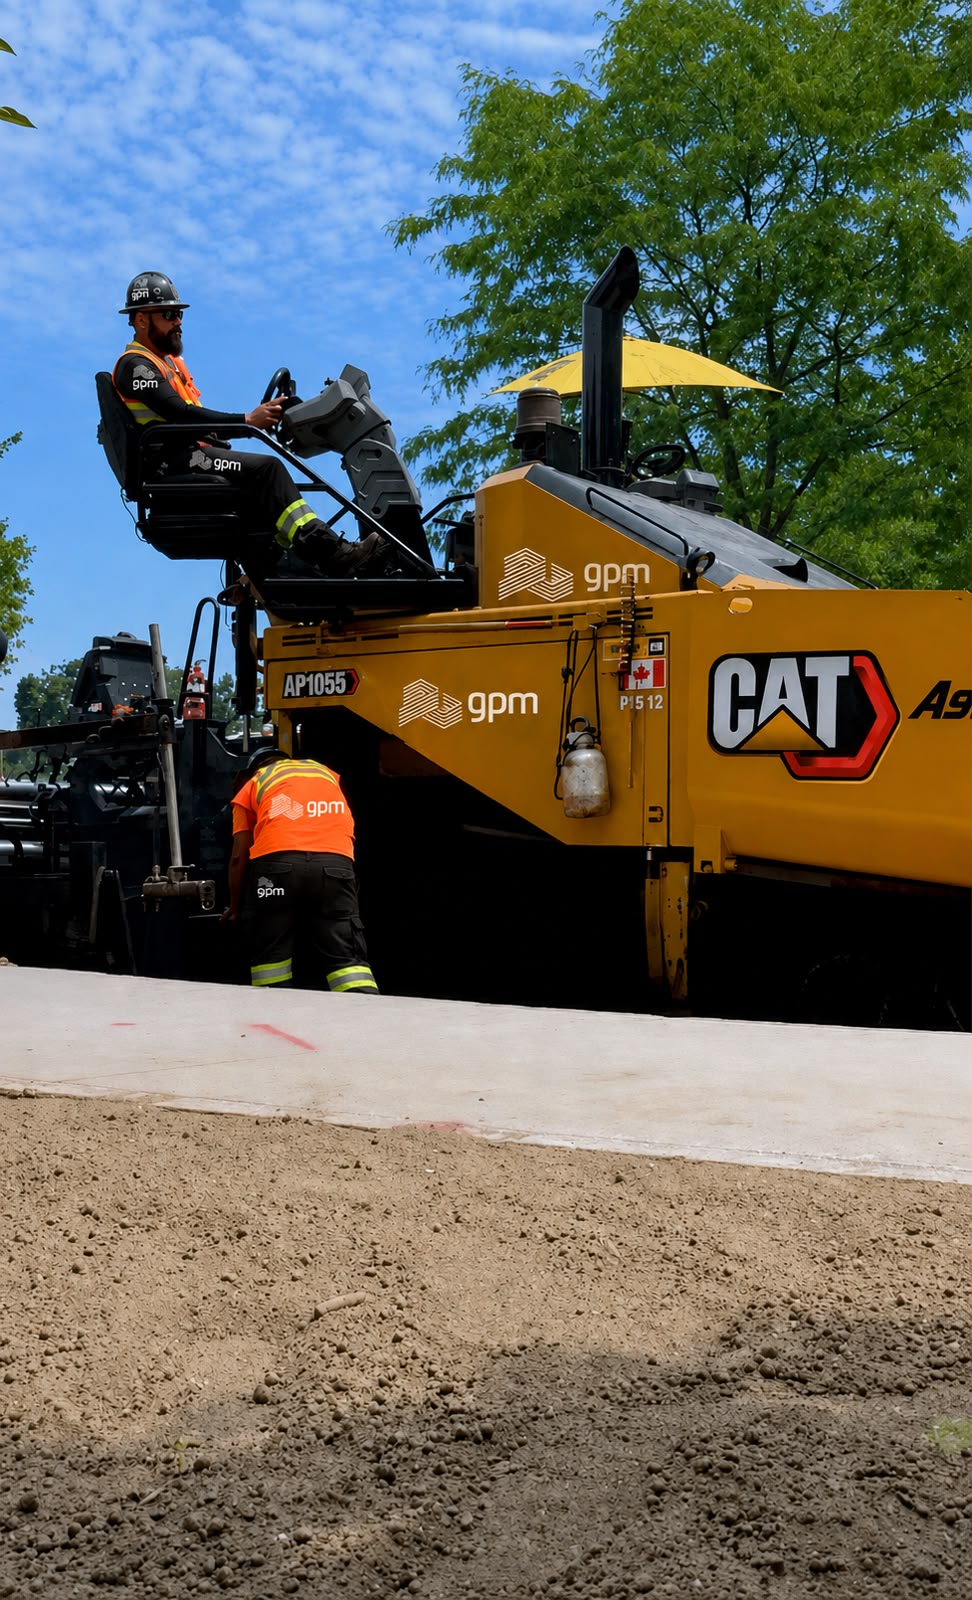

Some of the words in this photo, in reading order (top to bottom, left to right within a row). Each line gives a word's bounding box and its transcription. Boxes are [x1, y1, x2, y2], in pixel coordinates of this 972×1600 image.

[132, 379, 159, 391] gpm
[213, 458, 242, 471] gpm
[583, 563, 650, 592] gpm
[283, 670, 347, 698] AP1055
[467, 691, 539, 723] gpm
[712, 655, 850, 749] CAT
[907, 680, 972, 720] Ag
[306, 800, 345, 818] gpm
[257, 887, 285, 898] gpm
